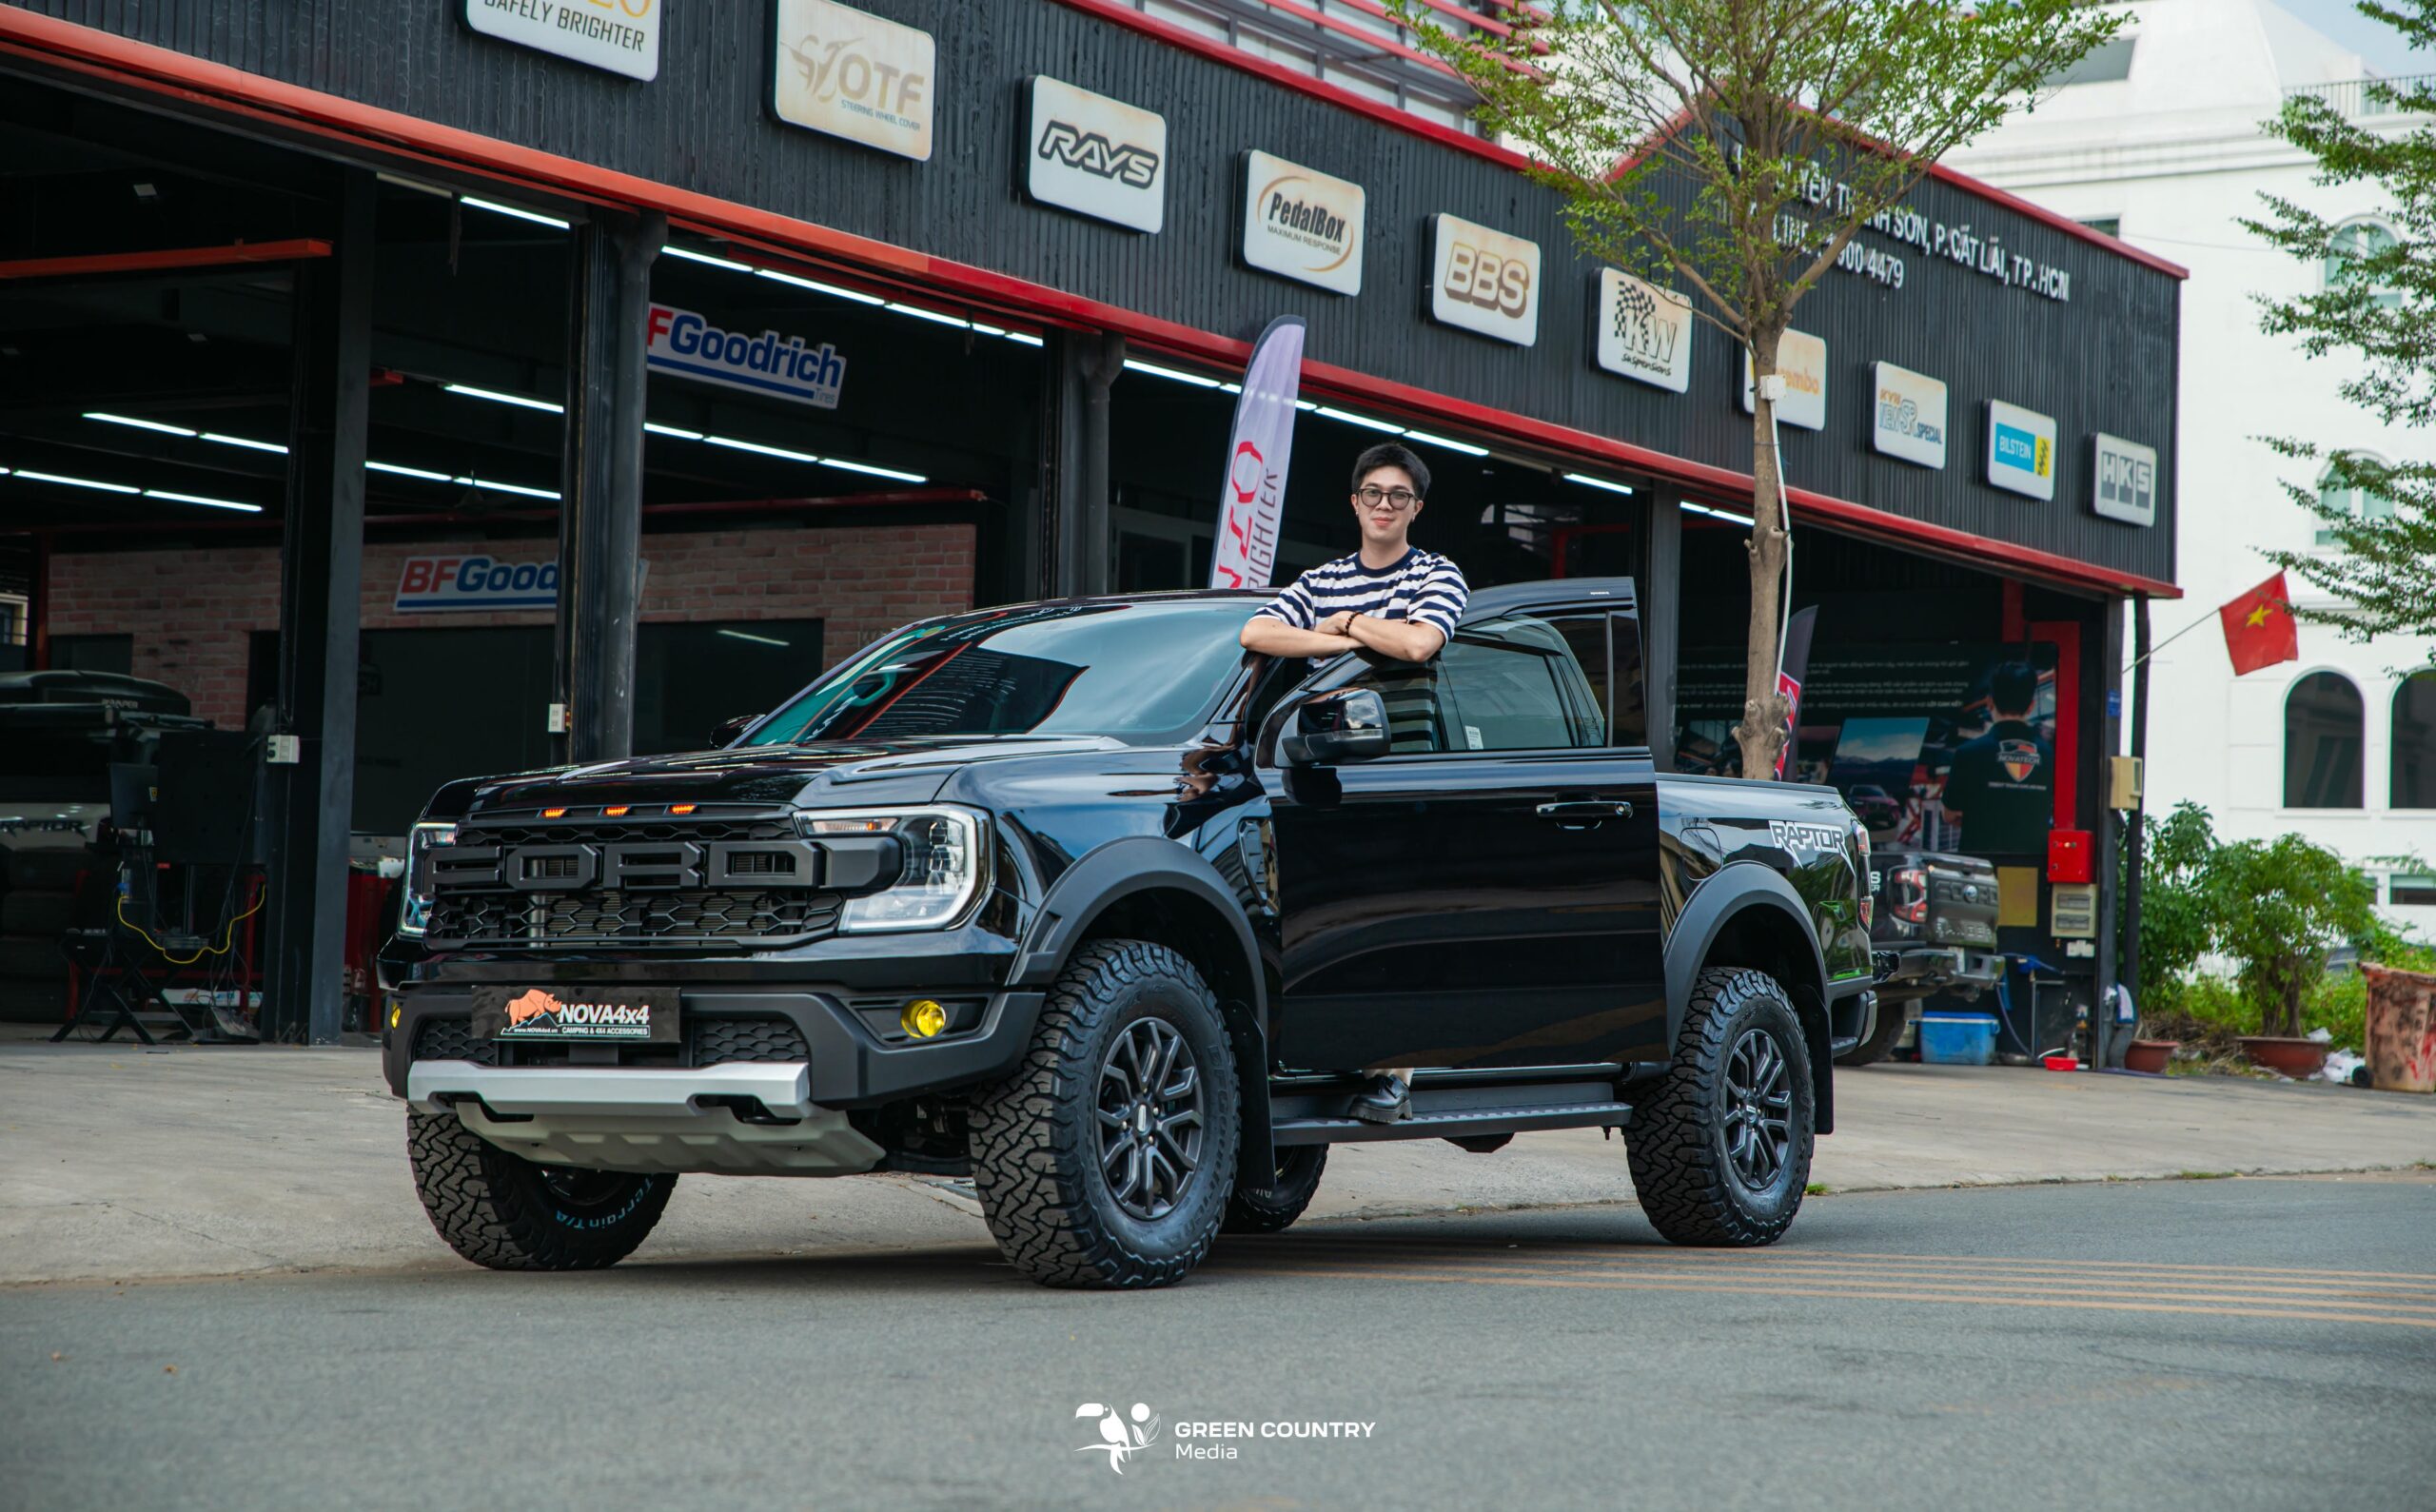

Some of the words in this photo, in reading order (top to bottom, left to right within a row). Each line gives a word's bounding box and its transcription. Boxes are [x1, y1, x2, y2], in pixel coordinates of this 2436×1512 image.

[558, 7, 645, 52] BRIGHTER
[841, 99, 874, 118] STEERING
[875, 108, 897, 125] WHEEL
[898, 118, 920, 131] COVER
[1038, 120, 1159, 189] RAYS
[1268, 191, 1346, 244] PedalBox
[1267, 225, 1302, 243] MAXIMUM
[1303, 235, 1342, 256] RESPONSE
[1444, 242, 1530, 320] BBS
[1867, 247, 1905, 289] 4479
[647, 307, 841, 388] FGoodrich
[1623, 307, 1678, 363] KW
[1621, 353, 1673, 377] suspensions
[815, 386, 836, 405] Tires
[1913, 422, 1943, 445] SPECIAL
[1999, 435, 2032, 461] BILSTEIN
[2101, 451, 2152, 500] HKS
[424, 838, 825, 894] FORD
[1768, 819, 1856, 877] RAPTOR
[558, 1004, 650, 1025] NOVA4x4
[589, 1027, 595, 1035] &
[606, 1027, 648, 1035] ACCESSORIES
[556, 1209, 585, 1229] T/A
